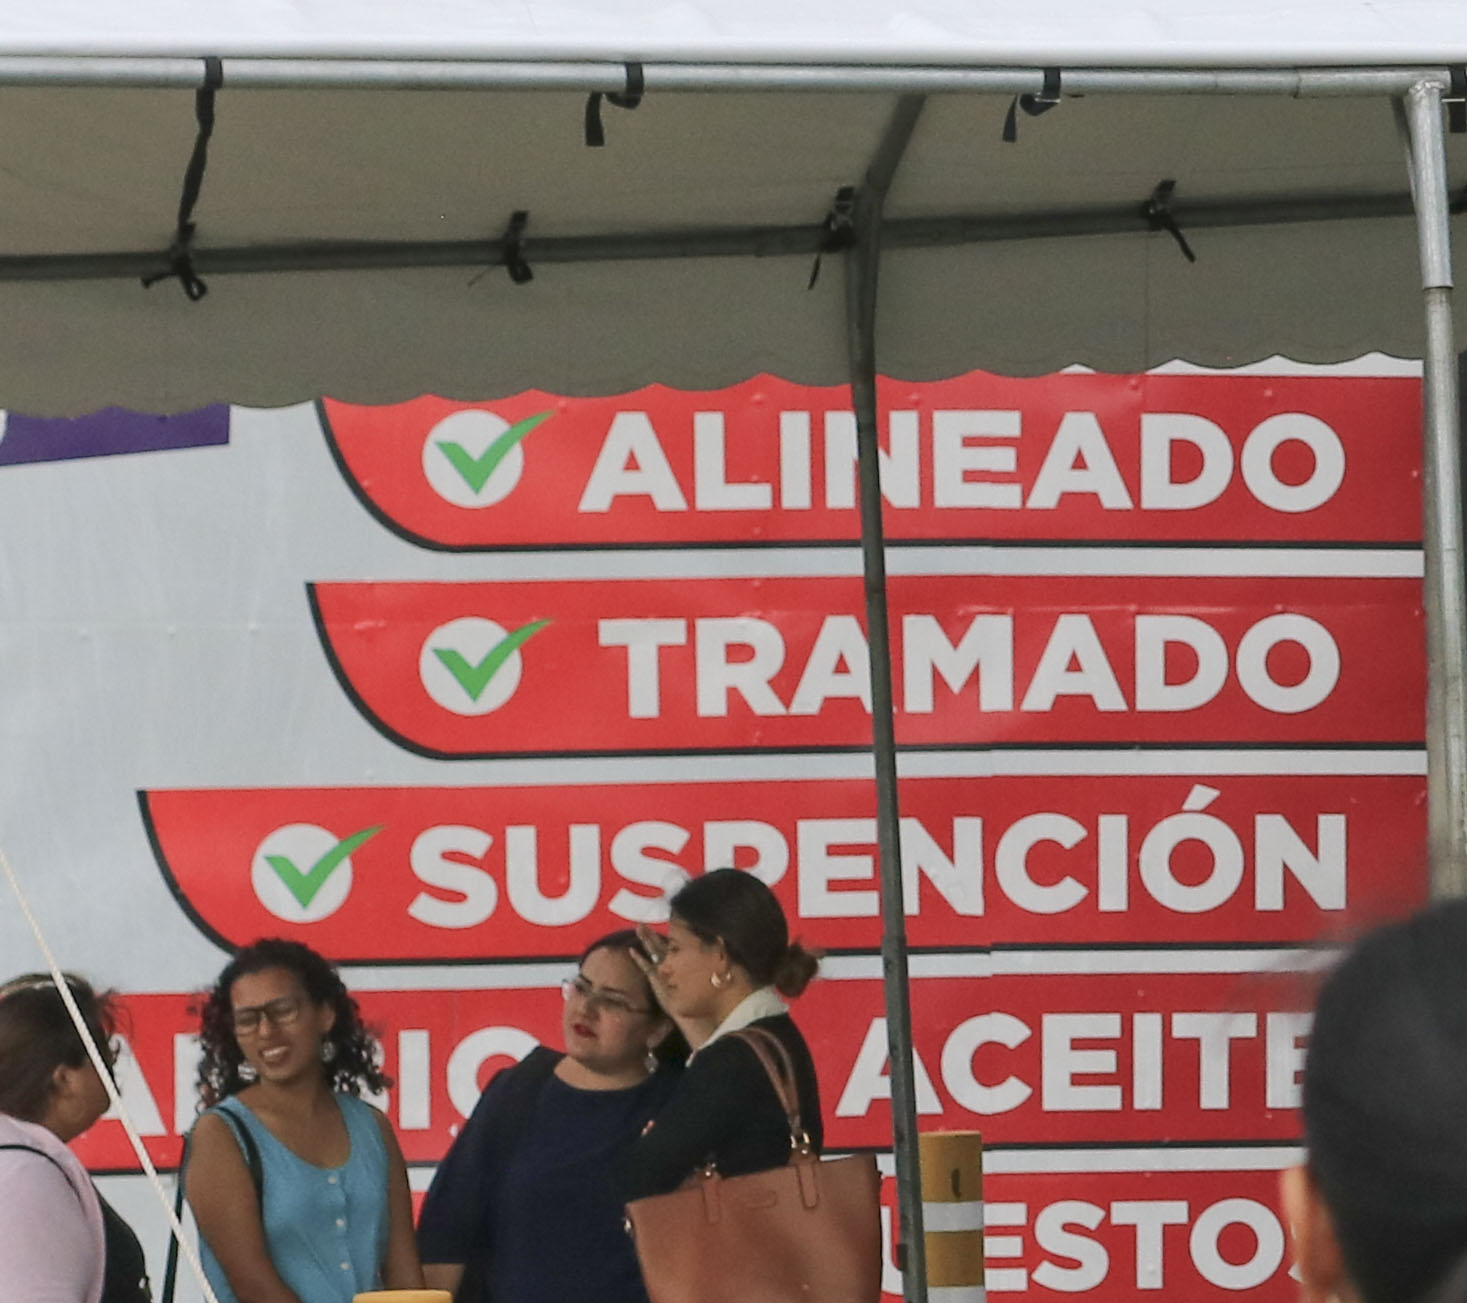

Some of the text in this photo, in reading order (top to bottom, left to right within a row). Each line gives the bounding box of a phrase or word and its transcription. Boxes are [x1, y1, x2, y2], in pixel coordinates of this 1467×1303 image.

[578, 409, 1346, 514] ALINEADO
[598, 611, 1341, 718] TRAMADO
[407, 783, 1348, 928] SUSPENCIÓN
